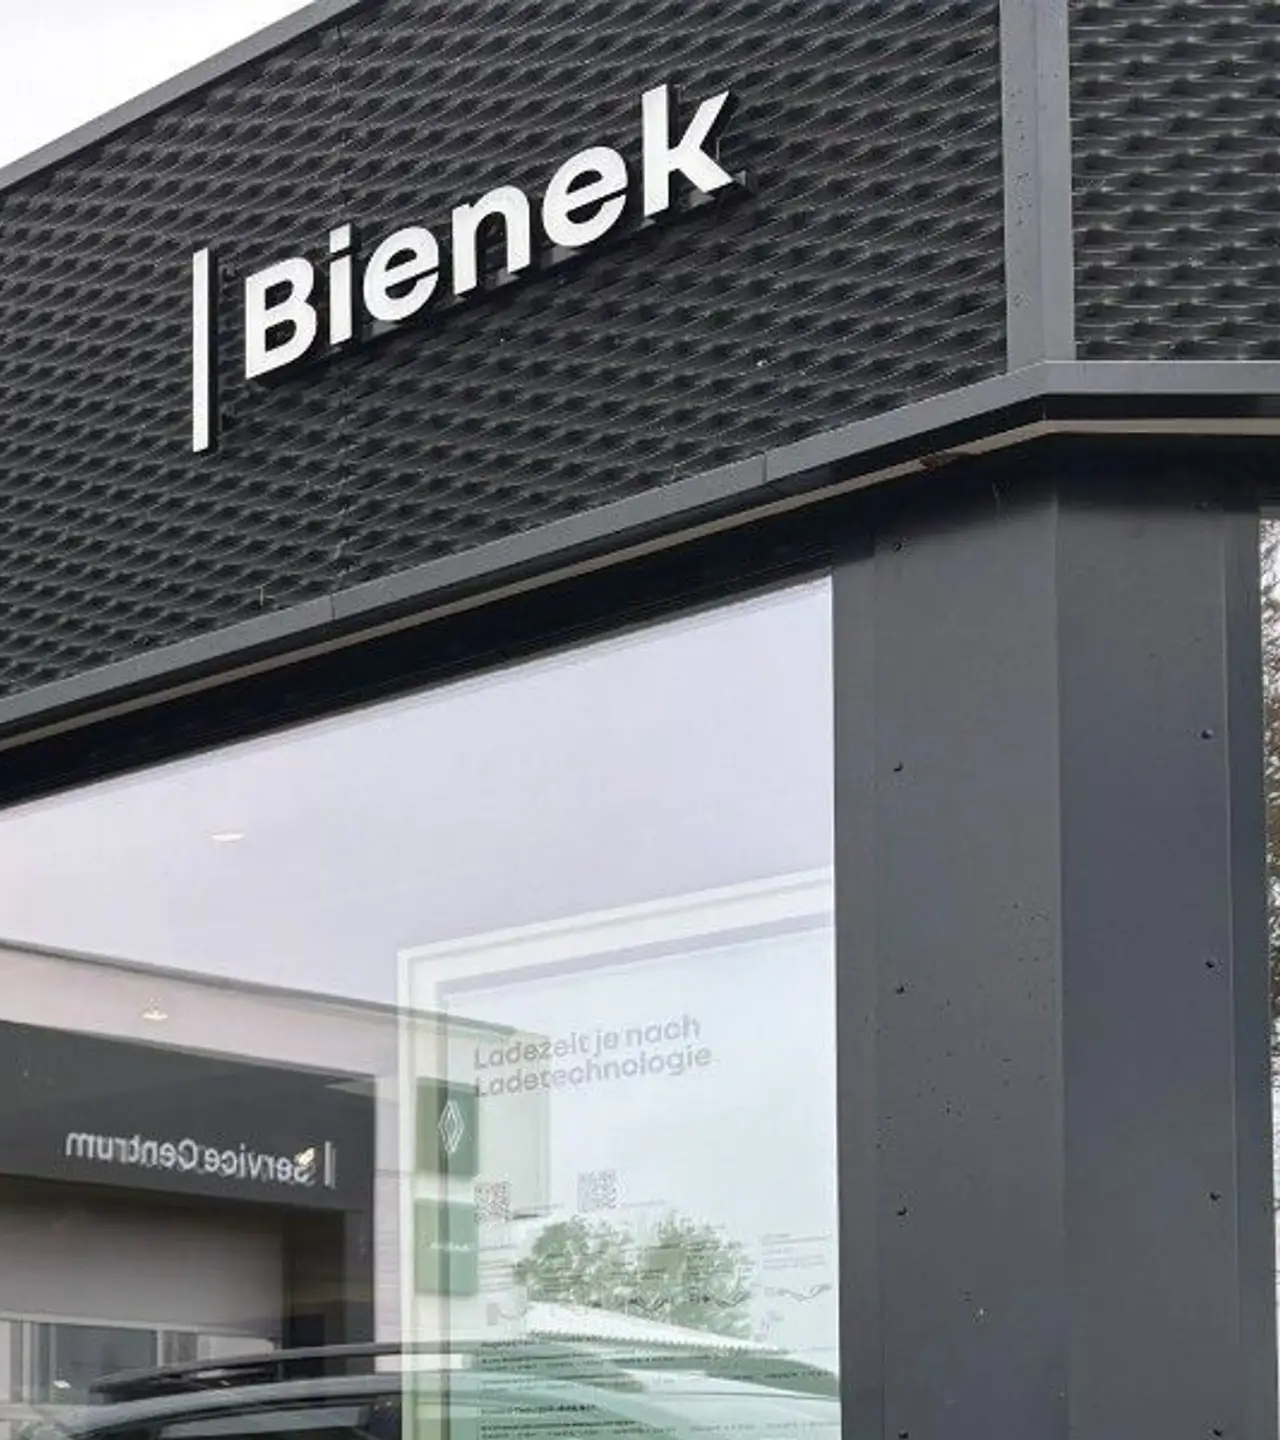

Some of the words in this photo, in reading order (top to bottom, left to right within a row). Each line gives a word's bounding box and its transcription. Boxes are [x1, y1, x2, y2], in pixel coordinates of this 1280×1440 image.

[244, 82, 735, 381] Bienek
[472, 1030, 591, 1071] Ladezeit
[594, 1029, 619, 1058] je
[624, 1013, 702, 1048] nach
[474, 1044, 714, 1099] Ladetechnologie
